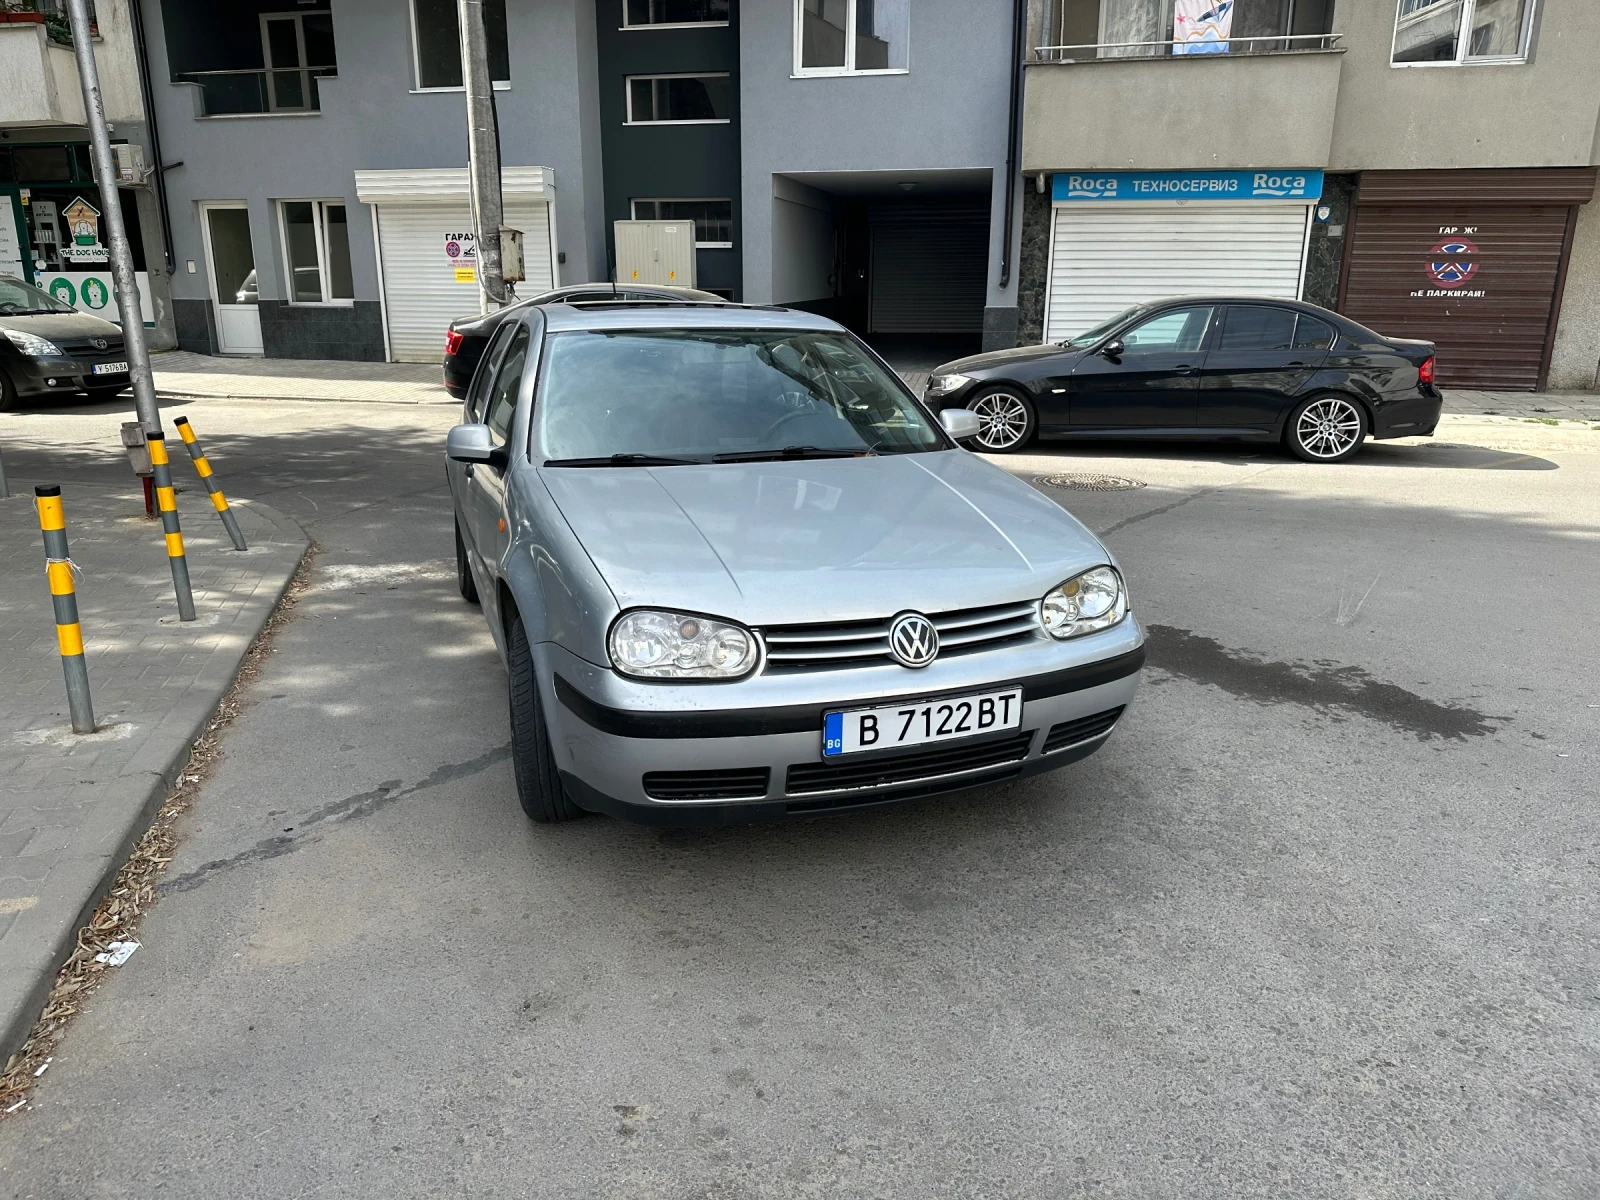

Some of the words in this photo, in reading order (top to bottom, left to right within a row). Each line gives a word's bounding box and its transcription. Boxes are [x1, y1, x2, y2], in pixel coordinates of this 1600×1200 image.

[1068, 175, 1118, 190] Roca
[1132, 179, 1238, 192] ТЕХНОСЕРВИЗ
[1253, 173, 1306, 188] Roca
[859, 714, 880, 746] B
[827, 739, 841, 749] BG
